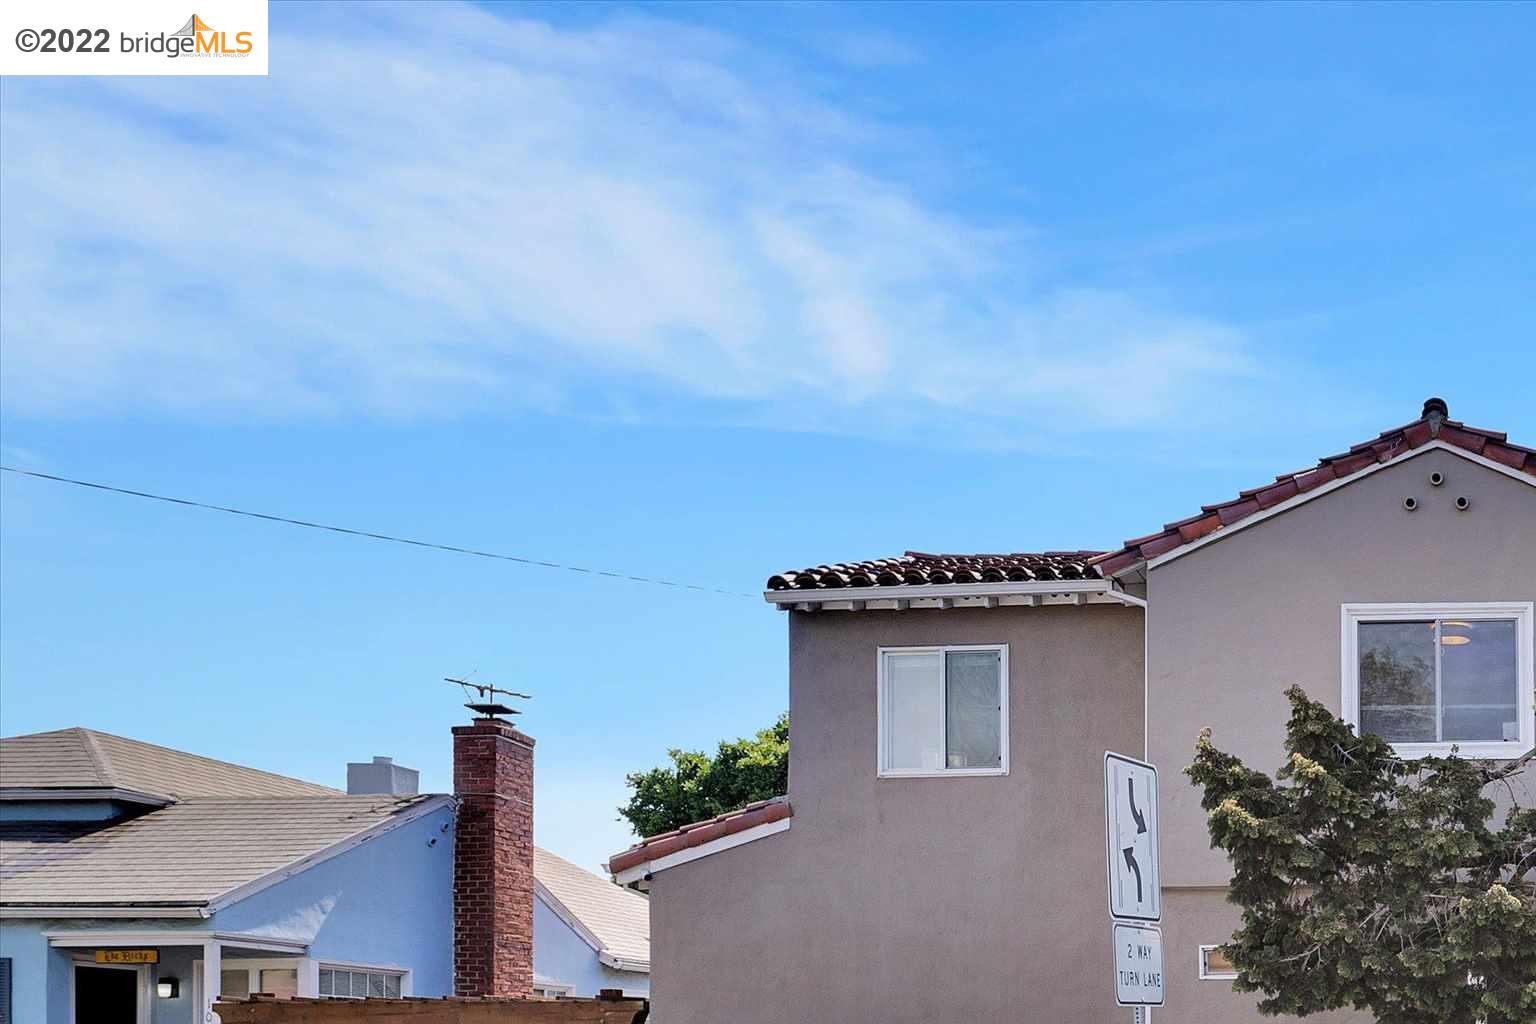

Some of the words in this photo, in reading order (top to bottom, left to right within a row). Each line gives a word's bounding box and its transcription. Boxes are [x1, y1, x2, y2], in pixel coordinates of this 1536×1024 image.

[1127, 943, 1132, 958] 2
[1137, 944, 1152, 960] WAY
[1120, 970, 1140, 986] TURN
[1143, 972, 1161, 988] LANE
